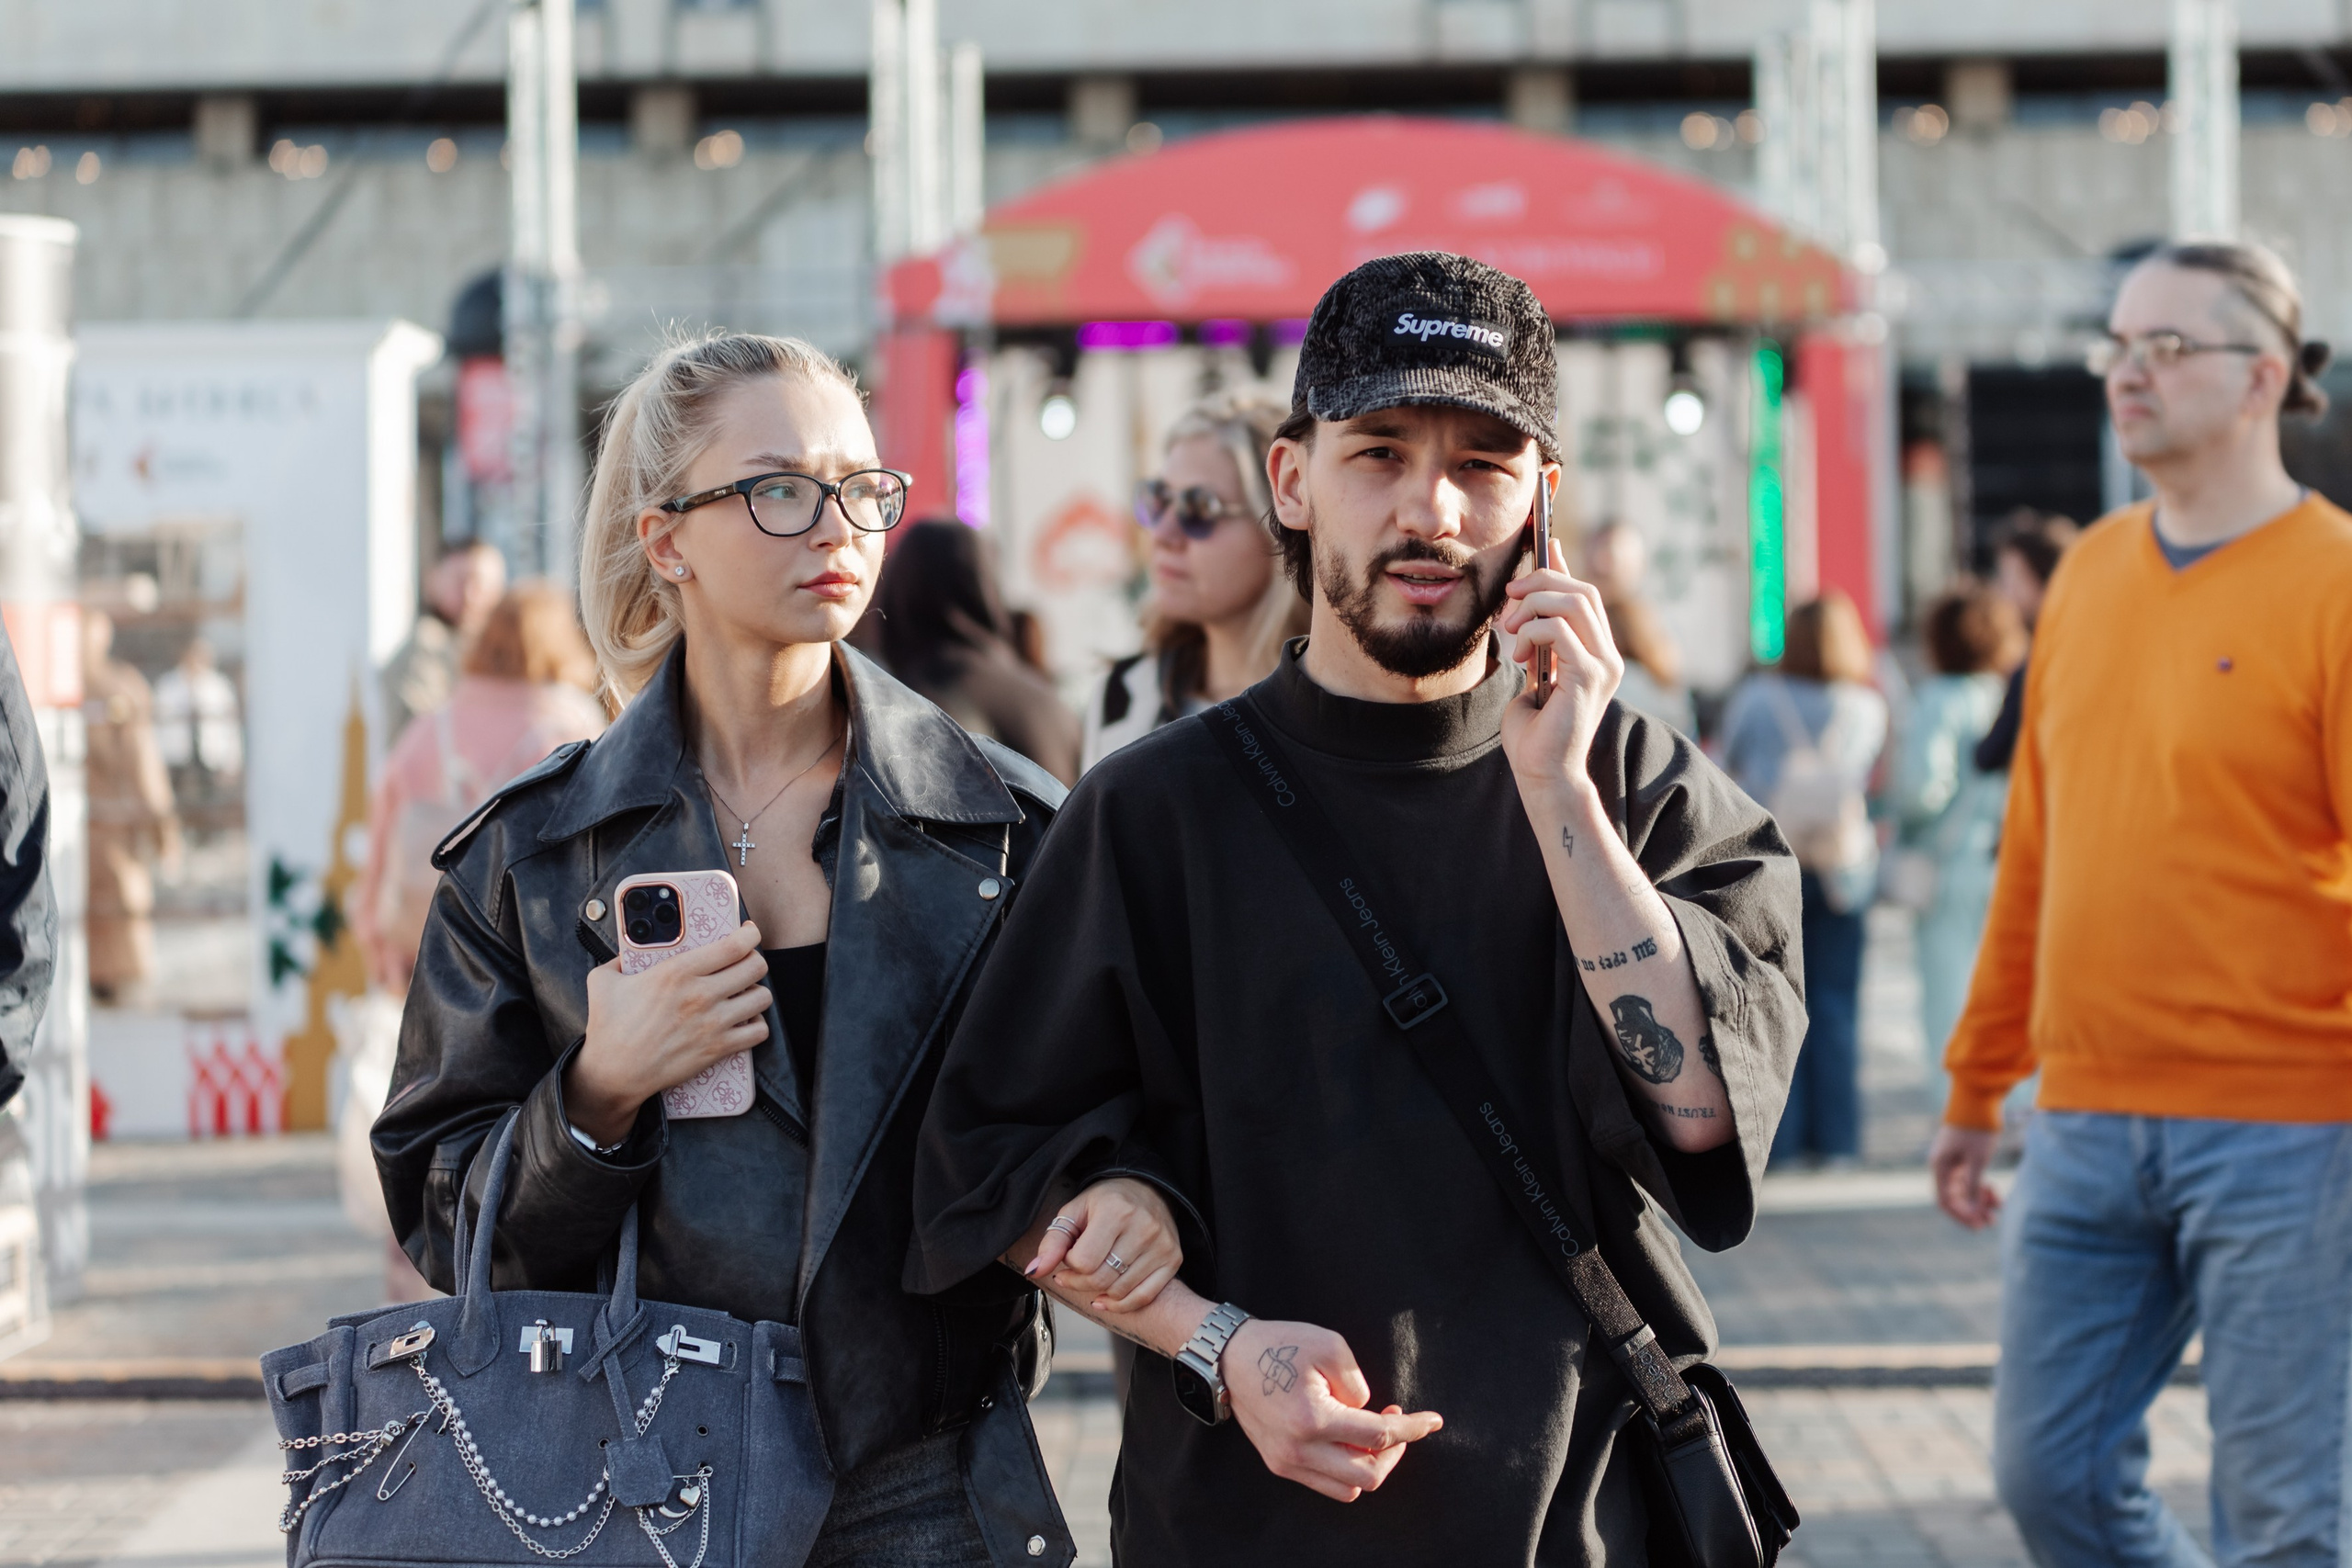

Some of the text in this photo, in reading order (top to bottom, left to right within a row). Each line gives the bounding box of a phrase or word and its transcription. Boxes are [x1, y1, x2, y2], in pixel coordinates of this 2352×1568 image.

[1394, 313, 1504, 347] Supreme
[1234, 722, 1264, 761] Klein
[1259, 756, 1295, 807] Calvin
[1340, 877, 1379, 929] Jeans
[1374, 931, 1406, 977] Klein
[1678, 1107, 1716, 1119] TRUST
[1479, 1102, 1579, 1257] Calvin Klein Jeans
